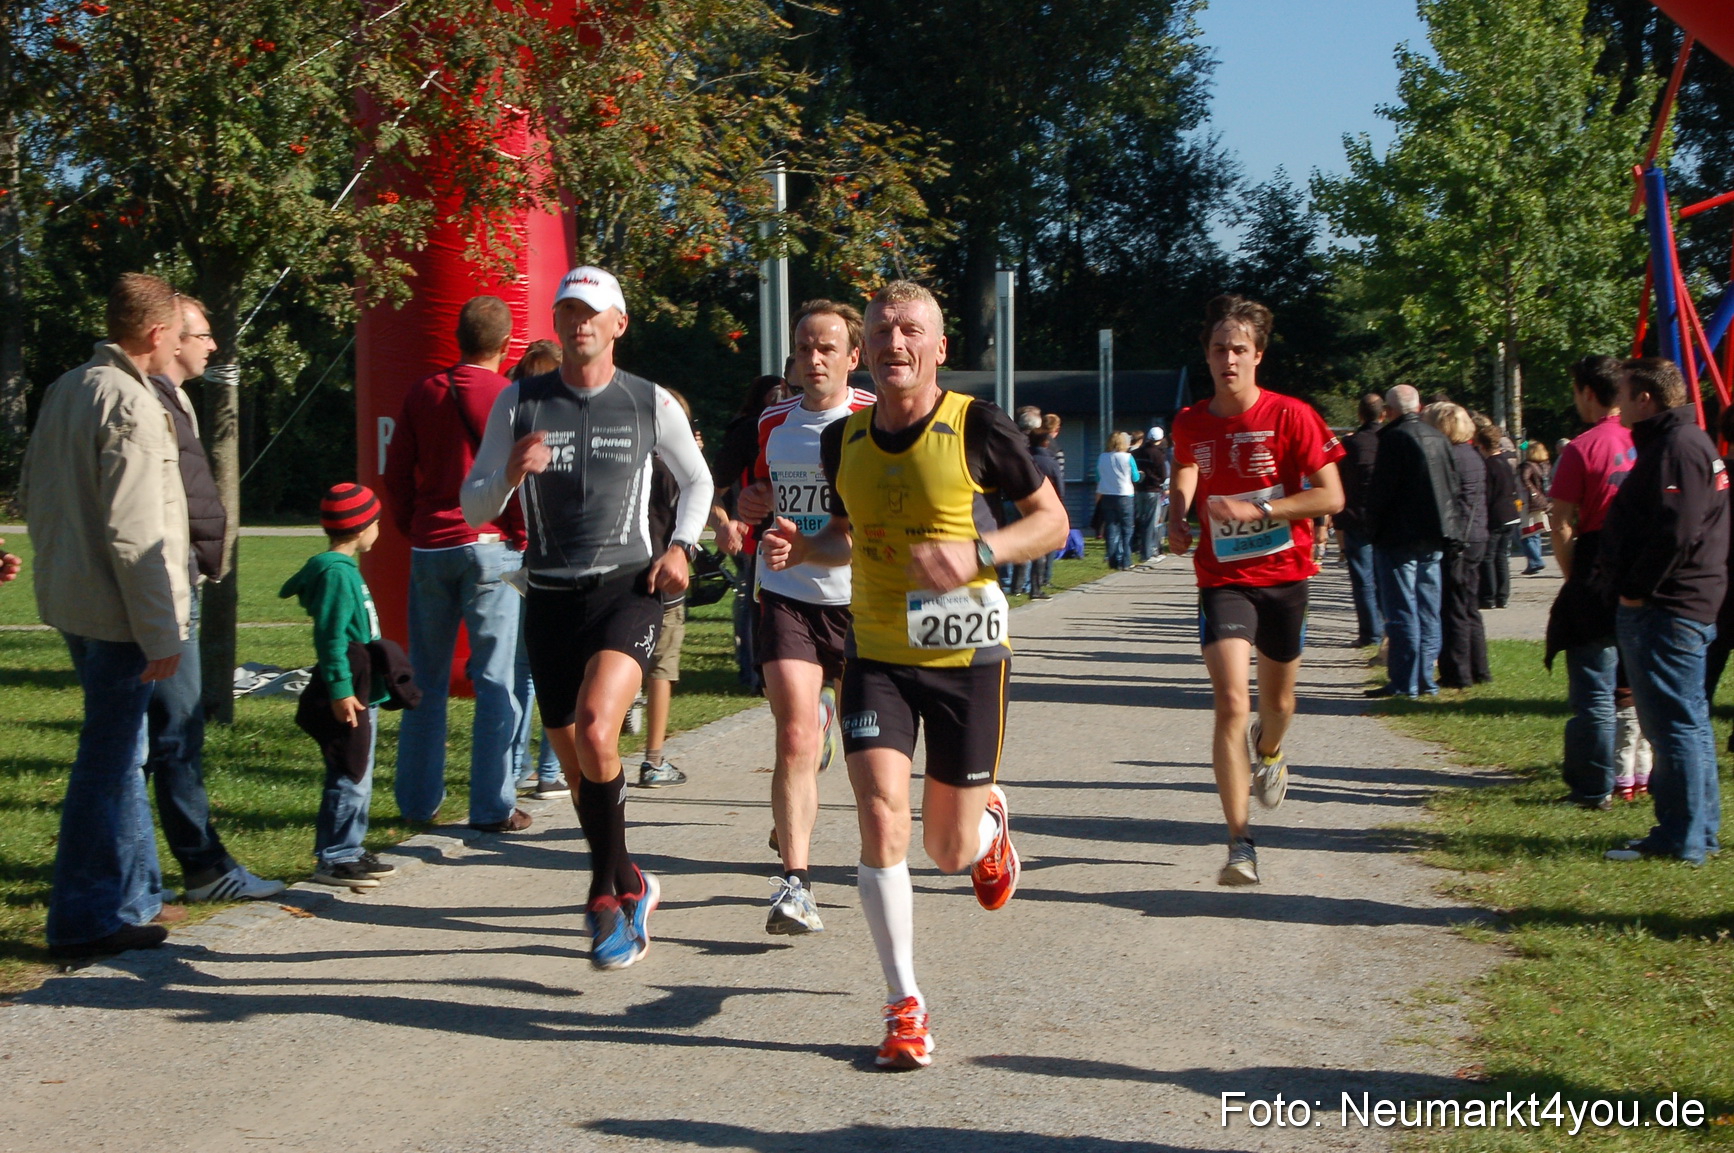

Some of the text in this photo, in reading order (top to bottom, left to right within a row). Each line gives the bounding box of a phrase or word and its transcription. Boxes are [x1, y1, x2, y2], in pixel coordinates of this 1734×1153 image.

[778, 484, 831, 513] 3276
[1232, 534, 1272, 552] Jakob
[921, 610, 1000, 646] 2626
